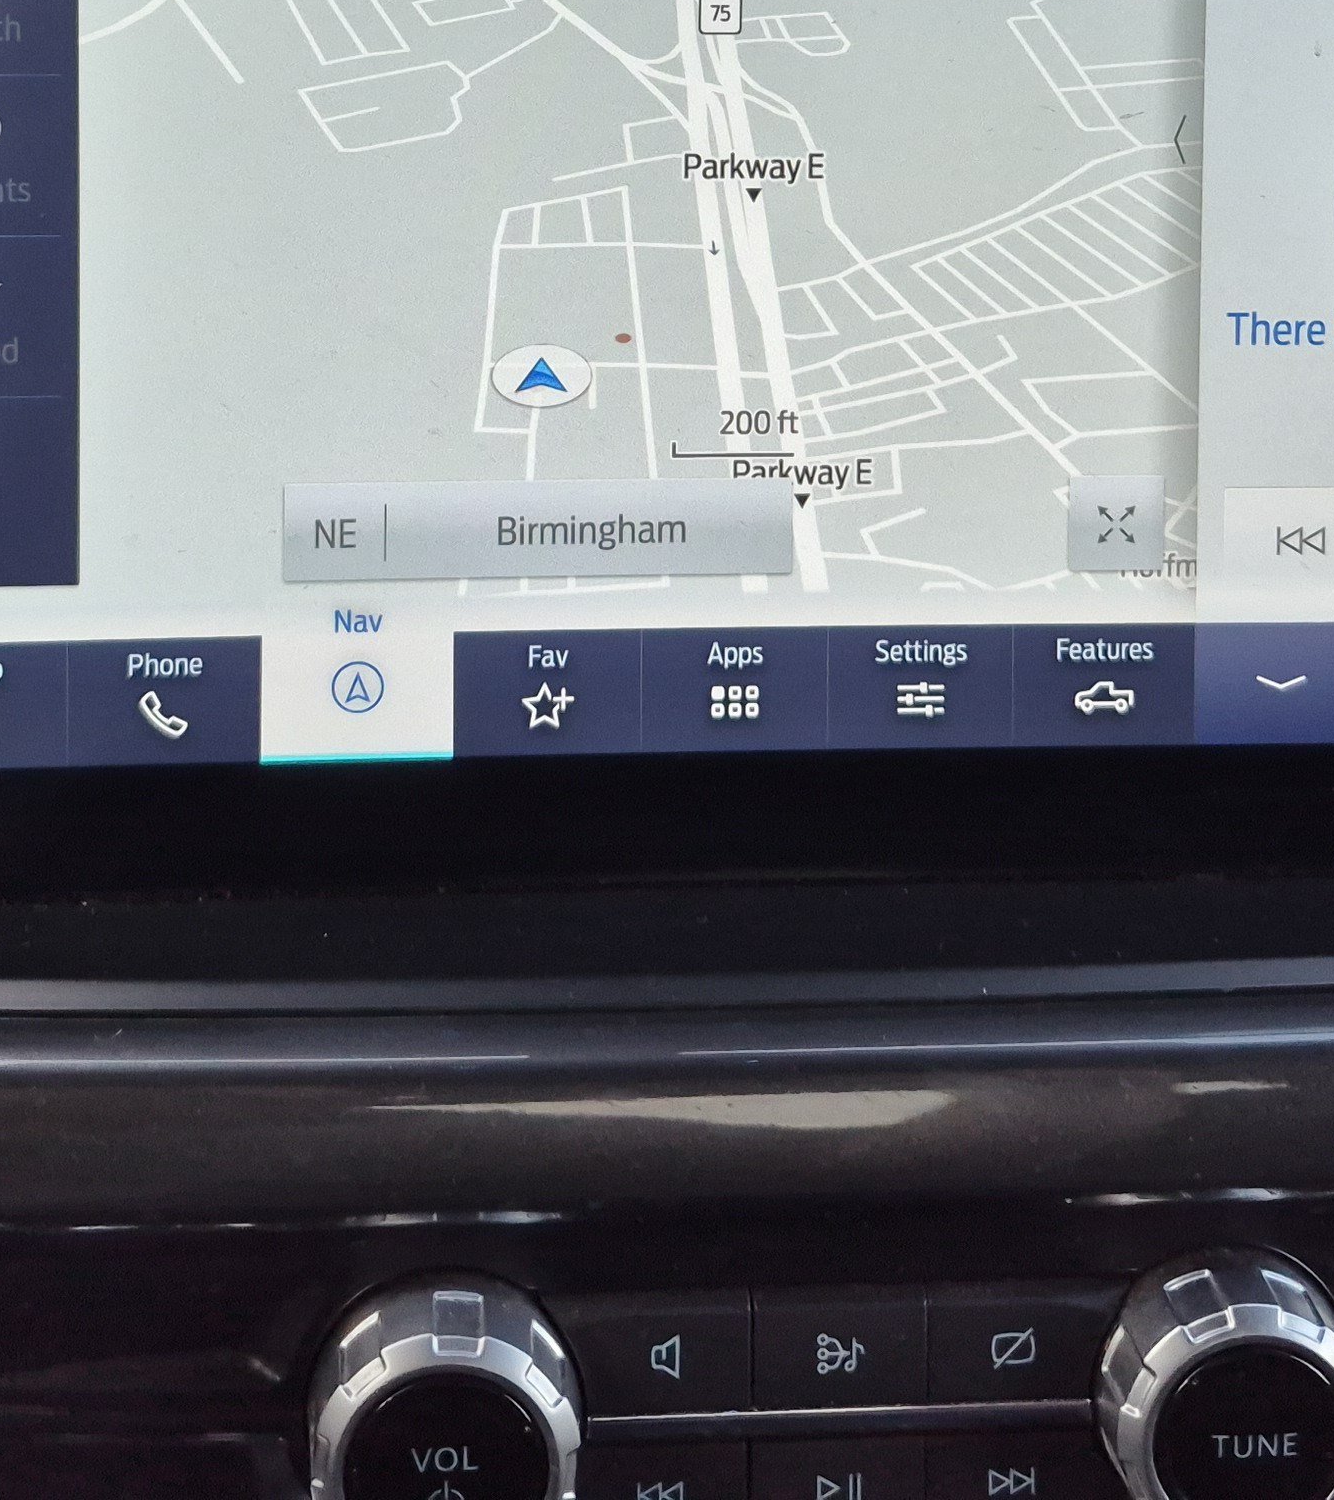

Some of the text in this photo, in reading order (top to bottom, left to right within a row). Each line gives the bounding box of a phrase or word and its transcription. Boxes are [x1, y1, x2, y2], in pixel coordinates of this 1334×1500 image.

[709, 4, 732, 22] 75
[682, 152, 825, 185] Parkway E
[1227, 313, 1326, 348] There
[720, 409, 799, 435] 200 ft
[857, 459, 872, 484] E
[313, 518, 357, 549] NE
[496, 512, 687, 550] Birmingham
[333, 609, 383, 635] Nav
[527, 644, 569, 670] Fav
[706, 641, 764, 673] Apps
[874, 638, 969, 669] Settings
[1056, 637, 1155, 664] Features
[127, 650, 203, 679] Phone
[1212, 1433, 1300, 1457] TUNE
[412, 1447, 478, 1473] VOL
